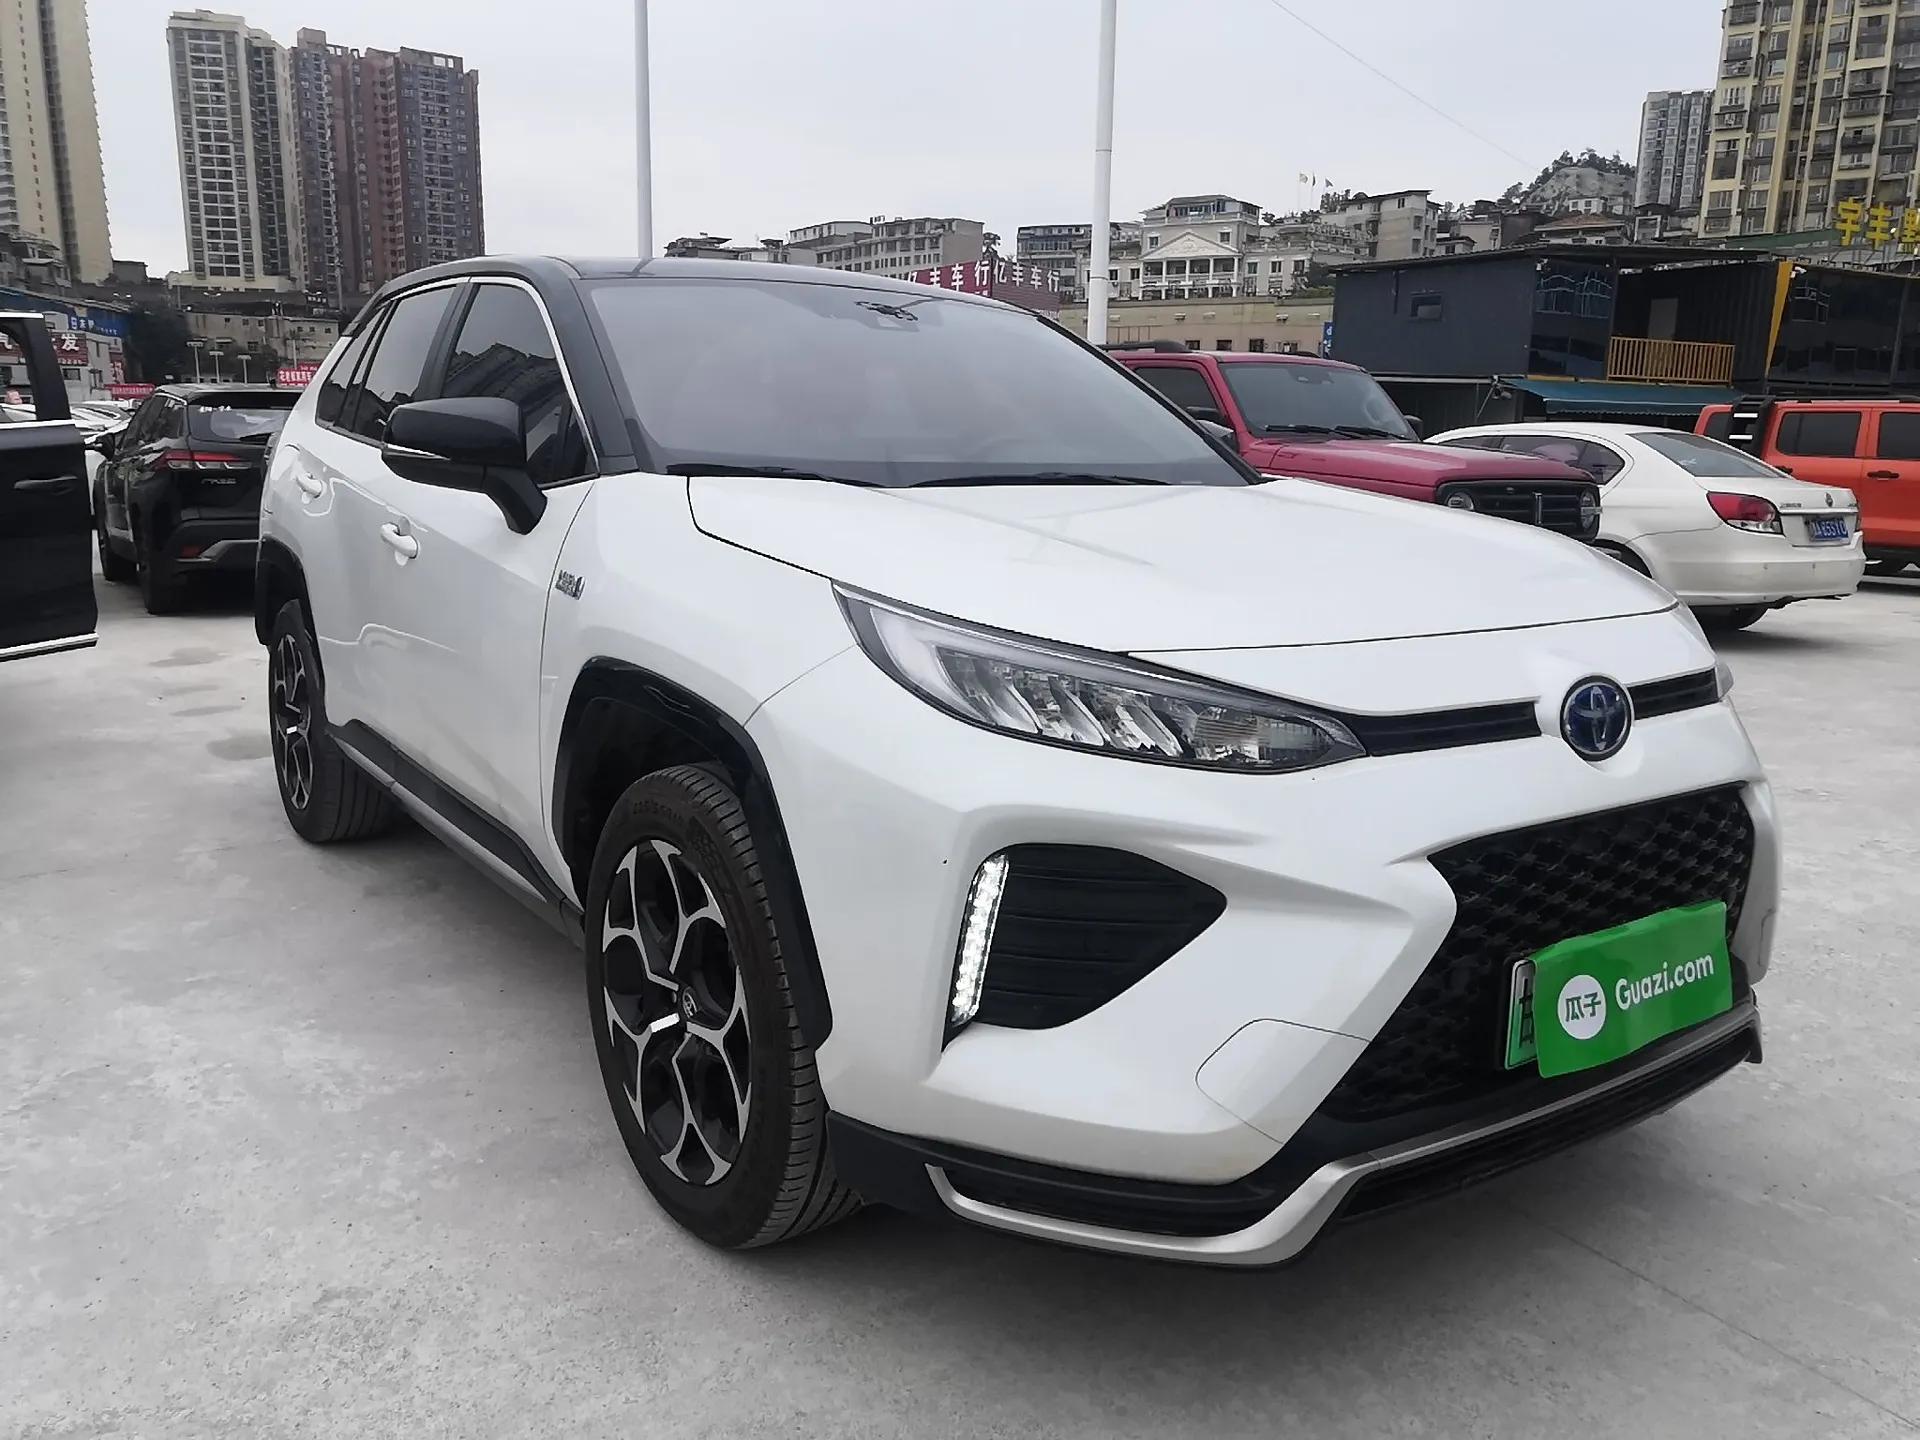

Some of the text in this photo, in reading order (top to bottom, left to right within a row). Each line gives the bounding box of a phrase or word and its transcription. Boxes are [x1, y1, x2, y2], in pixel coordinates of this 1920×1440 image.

[994, 260, 1060, 292] 亿丰车行
[1615, 954, 1714, 1010] Guazi.com
[1565, 992, 1602, 1022] 瓜子
